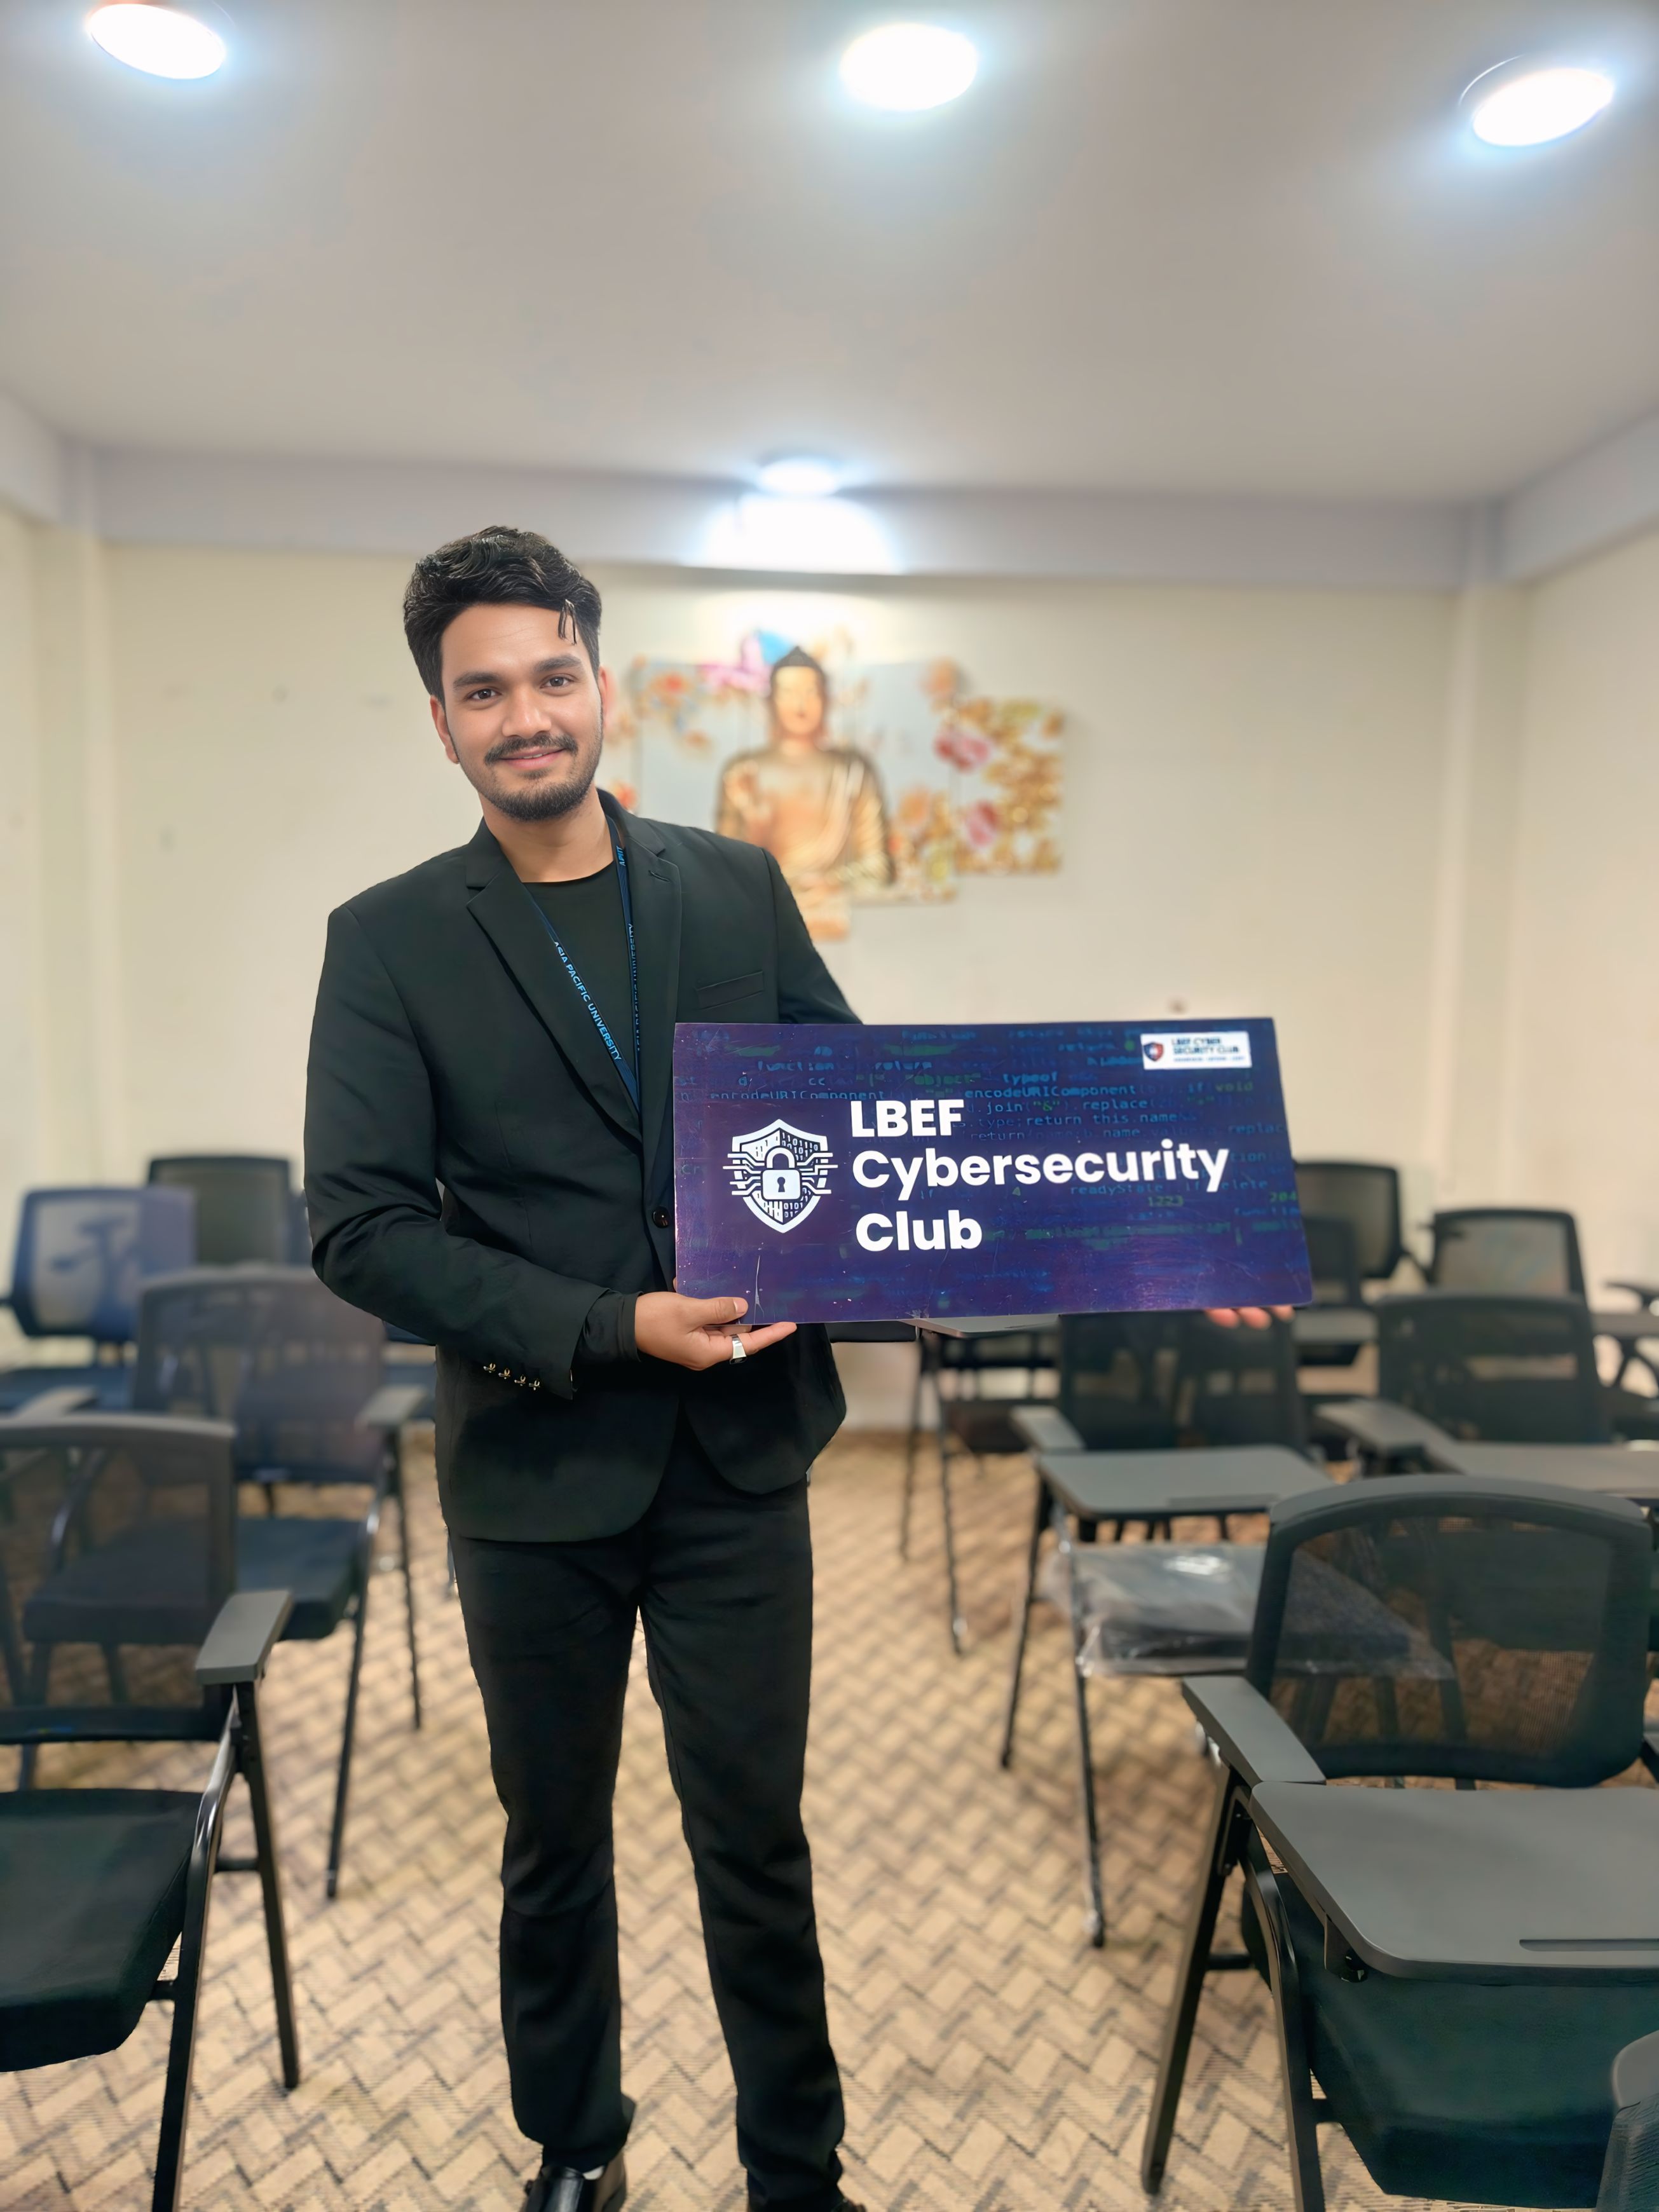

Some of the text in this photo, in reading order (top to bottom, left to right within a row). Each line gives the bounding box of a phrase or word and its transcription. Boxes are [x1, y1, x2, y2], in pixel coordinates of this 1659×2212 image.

[554, 941, 622, 1060] ASIA PACIFIC UNIVERSITY
[964, 1085, 1137, 1098] encodeURIComponent
[851, 1100, 964, 1137] LBEF
[853, 1139, 1228, 1200] Cybersecurity
[856, 1210, 981, 1251] Club
